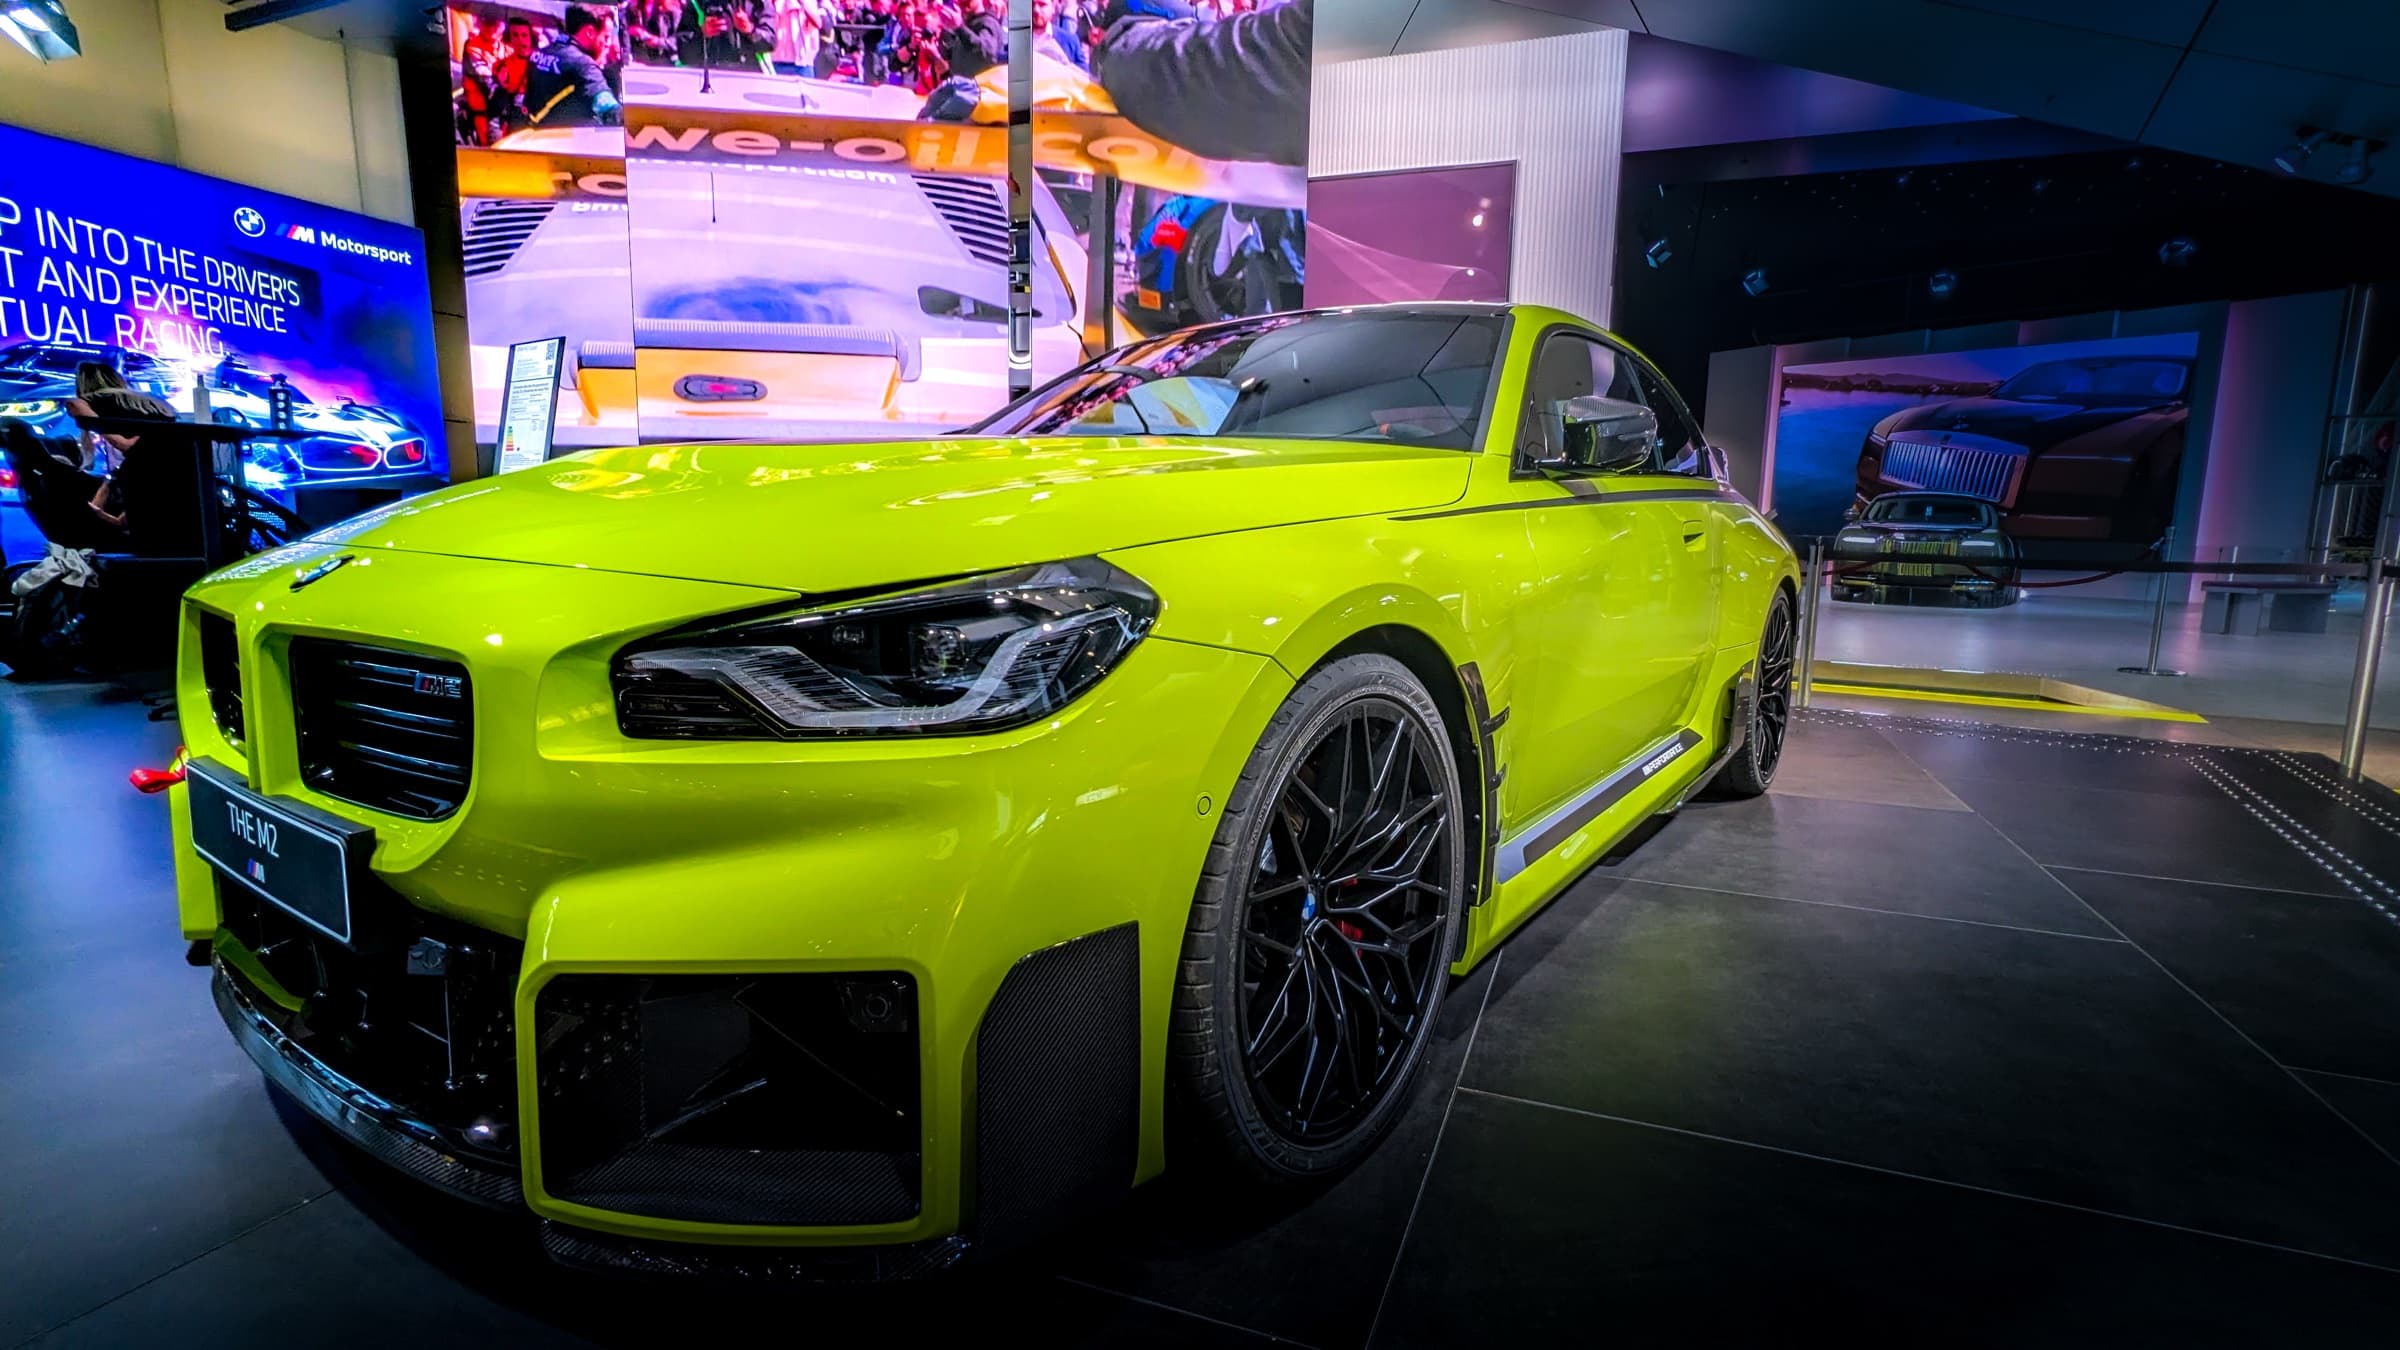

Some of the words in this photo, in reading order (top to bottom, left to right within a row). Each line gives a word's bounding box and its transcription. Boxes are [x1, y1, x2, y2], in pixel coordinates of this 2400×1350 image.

[35, 207, 129, 265] INTO
[133, 235, 199, 283] THE
[203, 255, 300, 306] DRIVER'S
[320, 230, 412, 265] Motorsport
[36, 256, 121, 305] AND
[131, 275, 287, 333] EXPERIENCE
[226, 801, 256, 845] THE
[256, 817, 280, 858] M2
